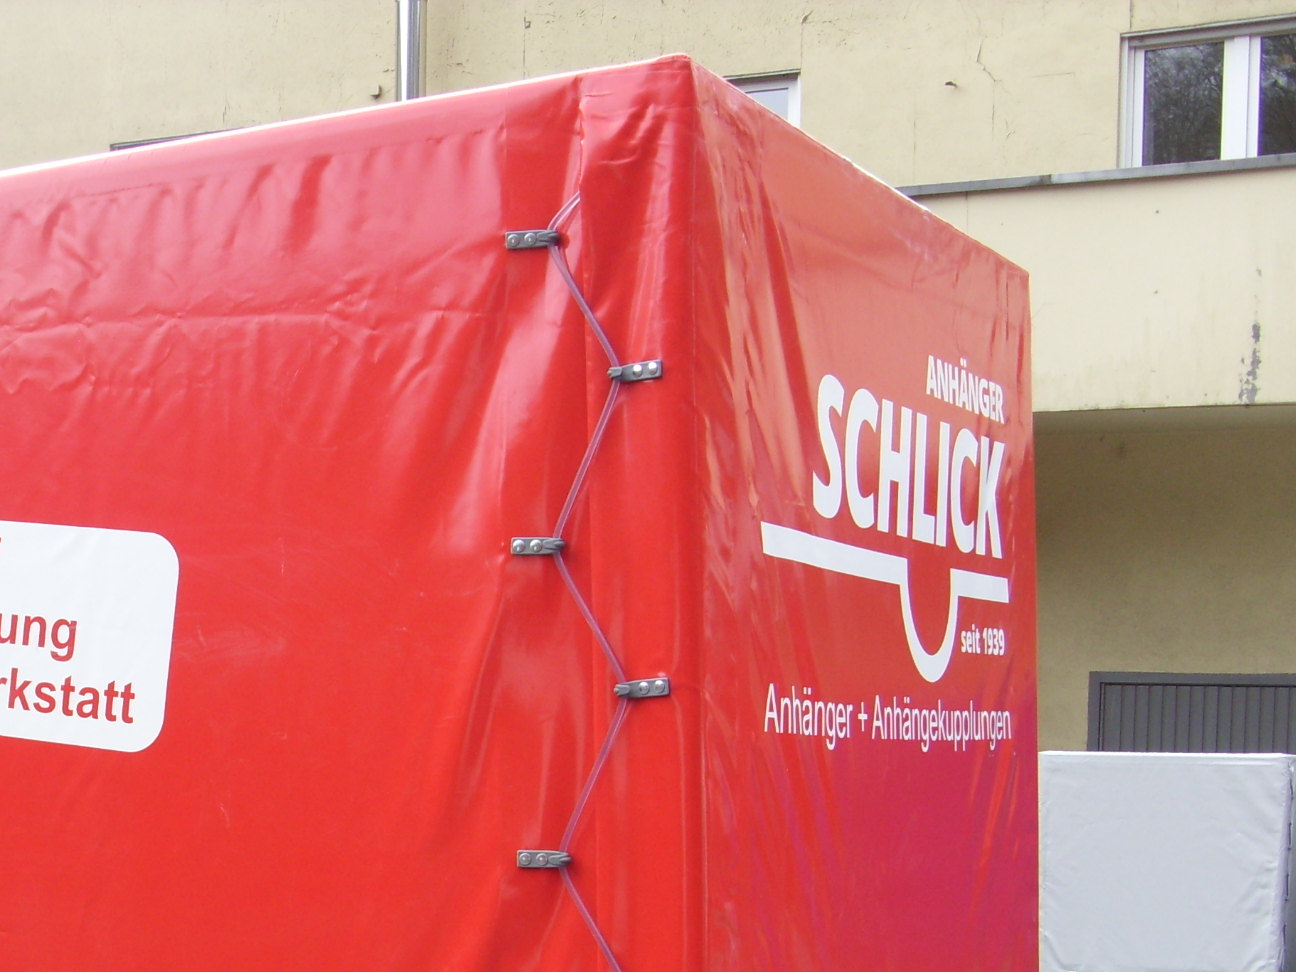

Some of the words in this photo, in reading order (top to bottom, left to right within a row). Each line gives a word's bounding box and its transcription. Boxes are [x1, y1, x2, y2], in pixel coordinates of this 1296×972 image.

[926, 354, 1005, 425] ANHÄNGER
[812, 373, 1005, 560] SCHLICK
[960, 624, 981, 655] seit
[982, 627, 1005, 656] 1939
[764, 682, 854, 751] Anhänger
[872, 694, 1012, 753] Anhängekupplungen
